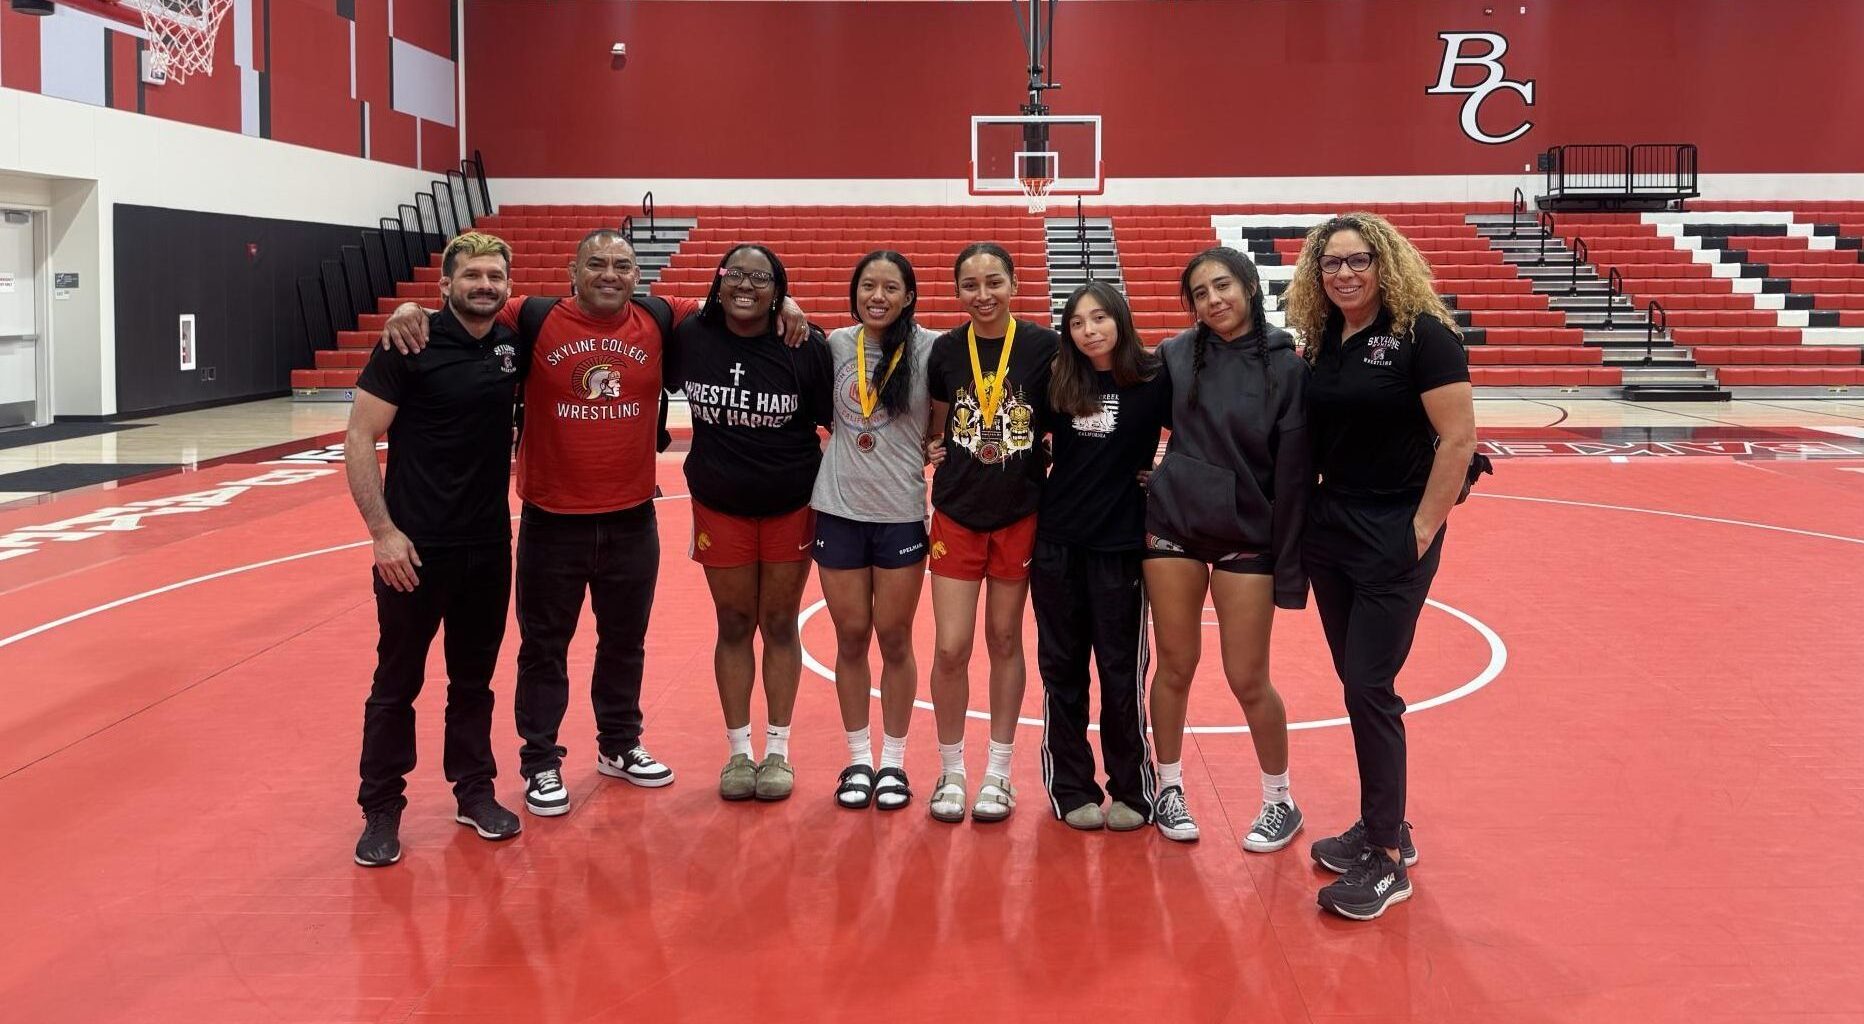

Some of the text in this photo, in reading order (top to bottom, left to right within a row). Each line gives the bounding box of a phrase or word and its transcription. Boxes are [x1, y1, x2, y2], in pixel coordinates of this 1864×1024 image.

[1425, 31, 1536, 144] BC
[547, 338, 648, 366] SKYLINE COLLEGE
[1367, 335, 1401, 350] SKYLINE
[685, 380, 799, 414] WRESTLE HARD
[557, 402, 640, 420] WRESTLING
[1373, 872, 1396, 897] HOKA
